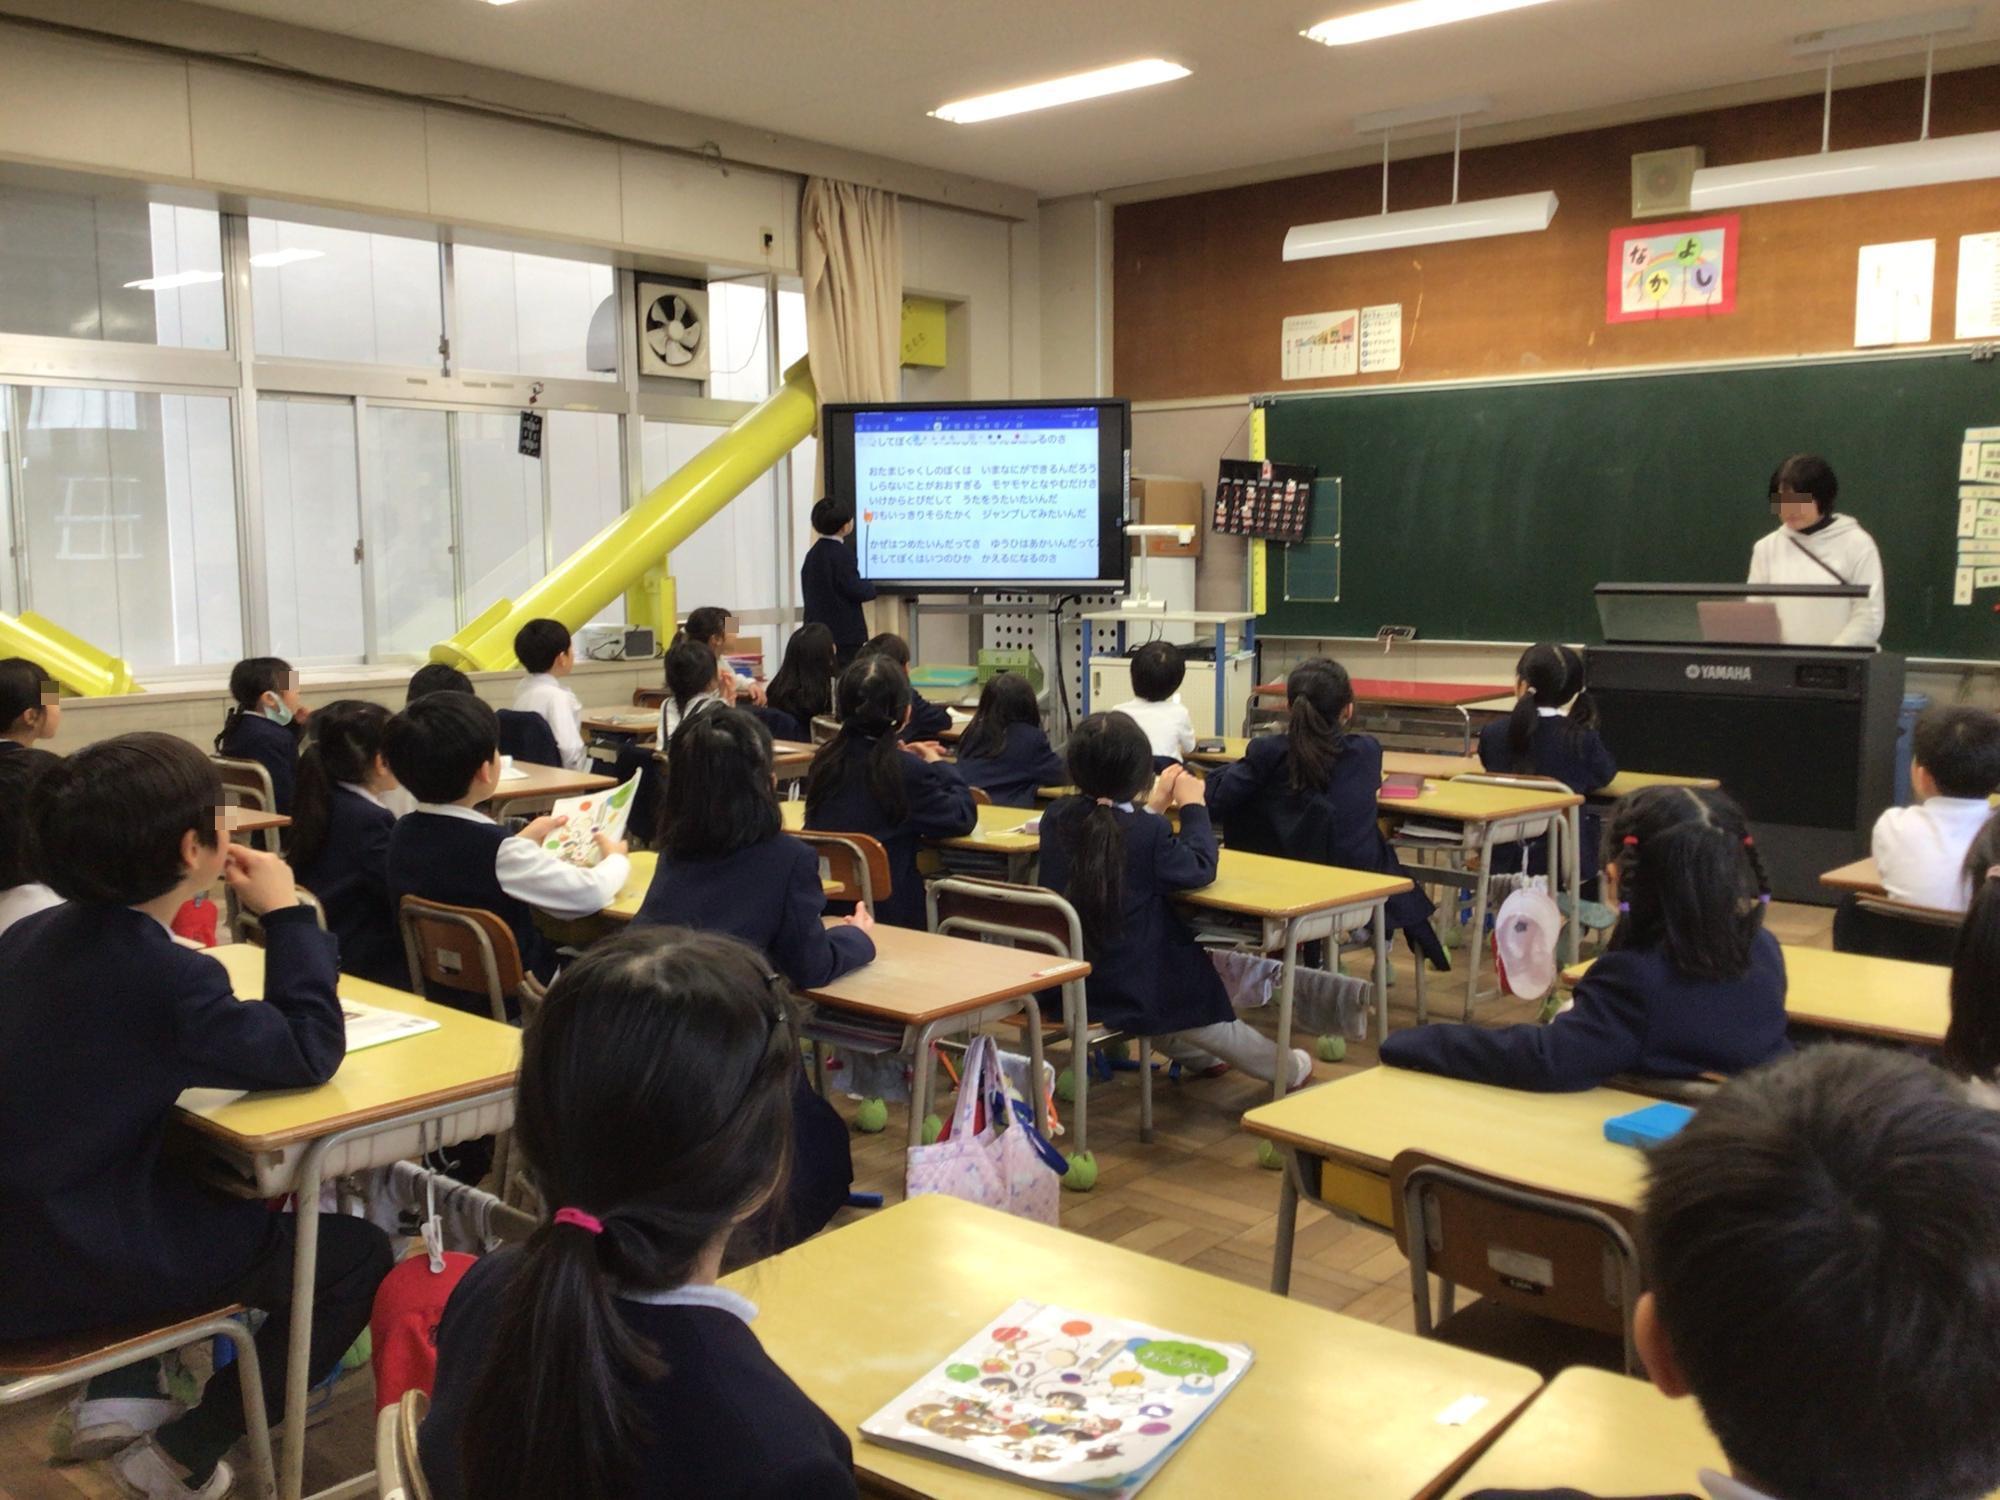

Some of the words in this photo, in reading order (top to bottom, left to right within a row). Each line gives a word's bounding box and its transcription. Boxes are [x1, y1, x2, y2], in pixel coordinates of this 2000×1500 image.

[1629, 238, 1713, 293] なかよし
[869, 465, 972, 477] おたまじゃくしのぼくは
[981, 463, 1097, 475] いまなにができるんだろう
[870, 480, 982, 491] しらないことがおおすぎる
[992, 479, 1097, 490] モヤモヤとなやむだけさ
[869, 495, 952, 506] いけからとびだして
[963, 494, 1058, 505] うたをうたいたいんだ
[983, 508, 1086, 519] ジャンプしてみたいんだ
[870, 539, 980, 550] かぜはつめたいんだってさ
[991, 538, 1099, 549] ゆうひはあかいんだって
[871, 553, 971, 564] そしてぼくはいつのひか
[982, 553, 1056, 564] かえるになるのさ
[1702, 665, 1751, 681] YAMAHA
